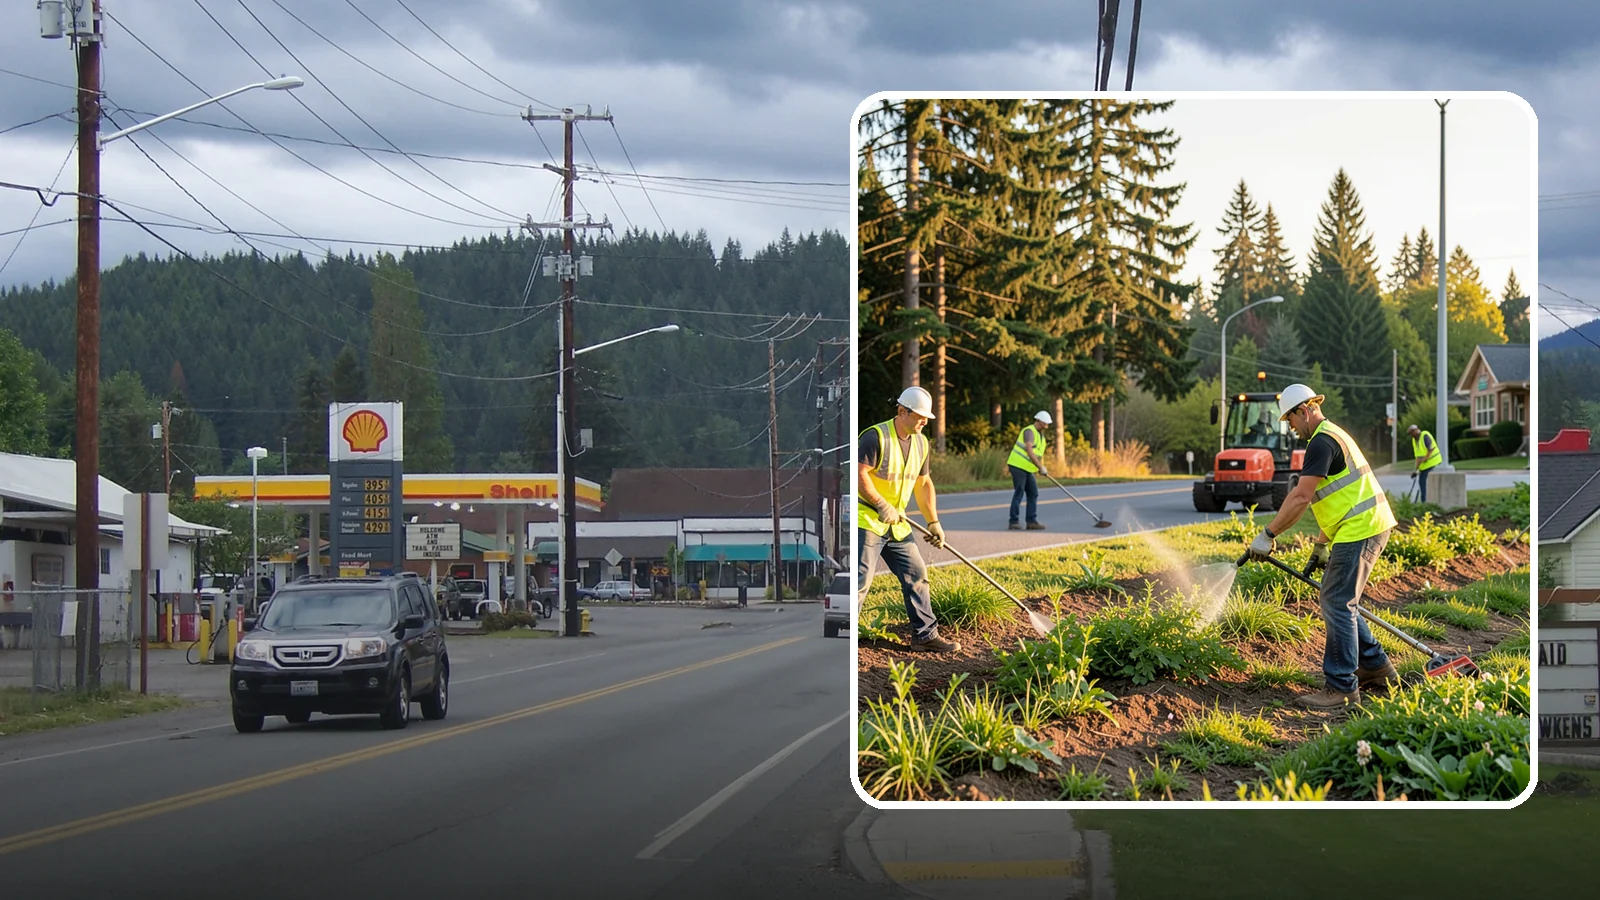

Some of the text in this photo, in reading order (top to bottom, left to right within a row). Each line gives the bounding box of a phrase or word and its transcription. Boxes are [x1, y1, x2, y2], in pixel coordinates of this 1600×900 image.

[366, 480, 384, 490] 395
[490, 484, 547, 499] Shell
[365, 494, 384, 504] 405
[365, 508, 384, 518] 415
[365, 522, 384, 533] 429
[1539, 643, 1566, 665] AID
